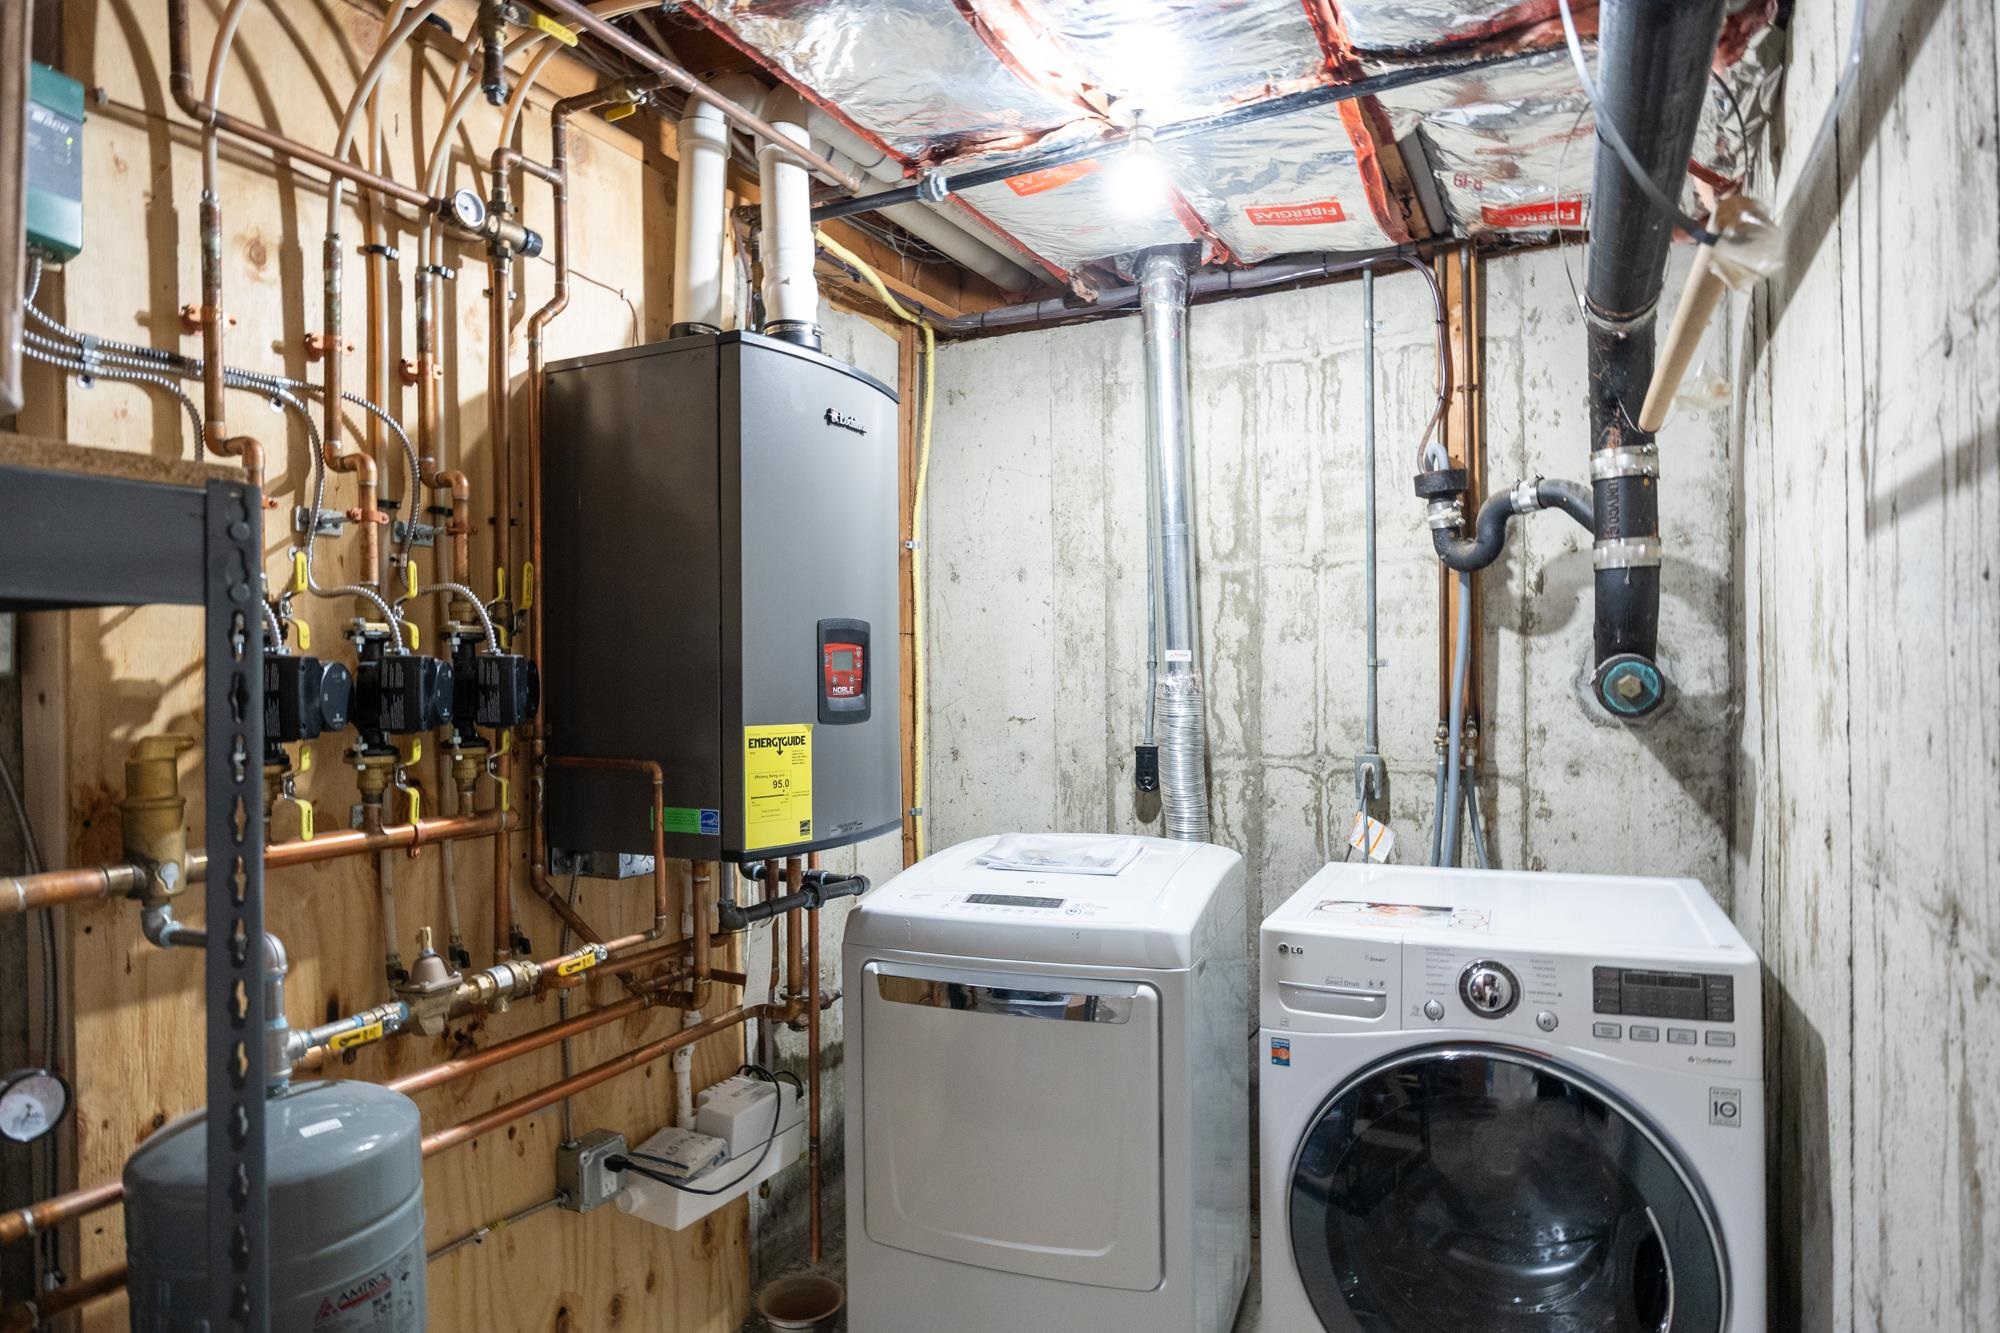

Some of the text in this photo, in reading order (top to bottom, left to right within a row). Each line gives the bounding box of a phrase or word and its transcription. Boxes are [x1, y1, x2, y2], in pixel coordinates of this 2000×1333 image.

[1453, 173, 1483, 191] R-19
[1253, 207, 1337, 219] FIBERGLAS
[832, 686, 854, 694] NOBLE
[748, 735, 806, 749] ENERGYGUIDE
[773, 779, 790, 789] 95.0
[1291, 946, 1304, 955] LG
[1713, 1100, 1737, 1118] 10
